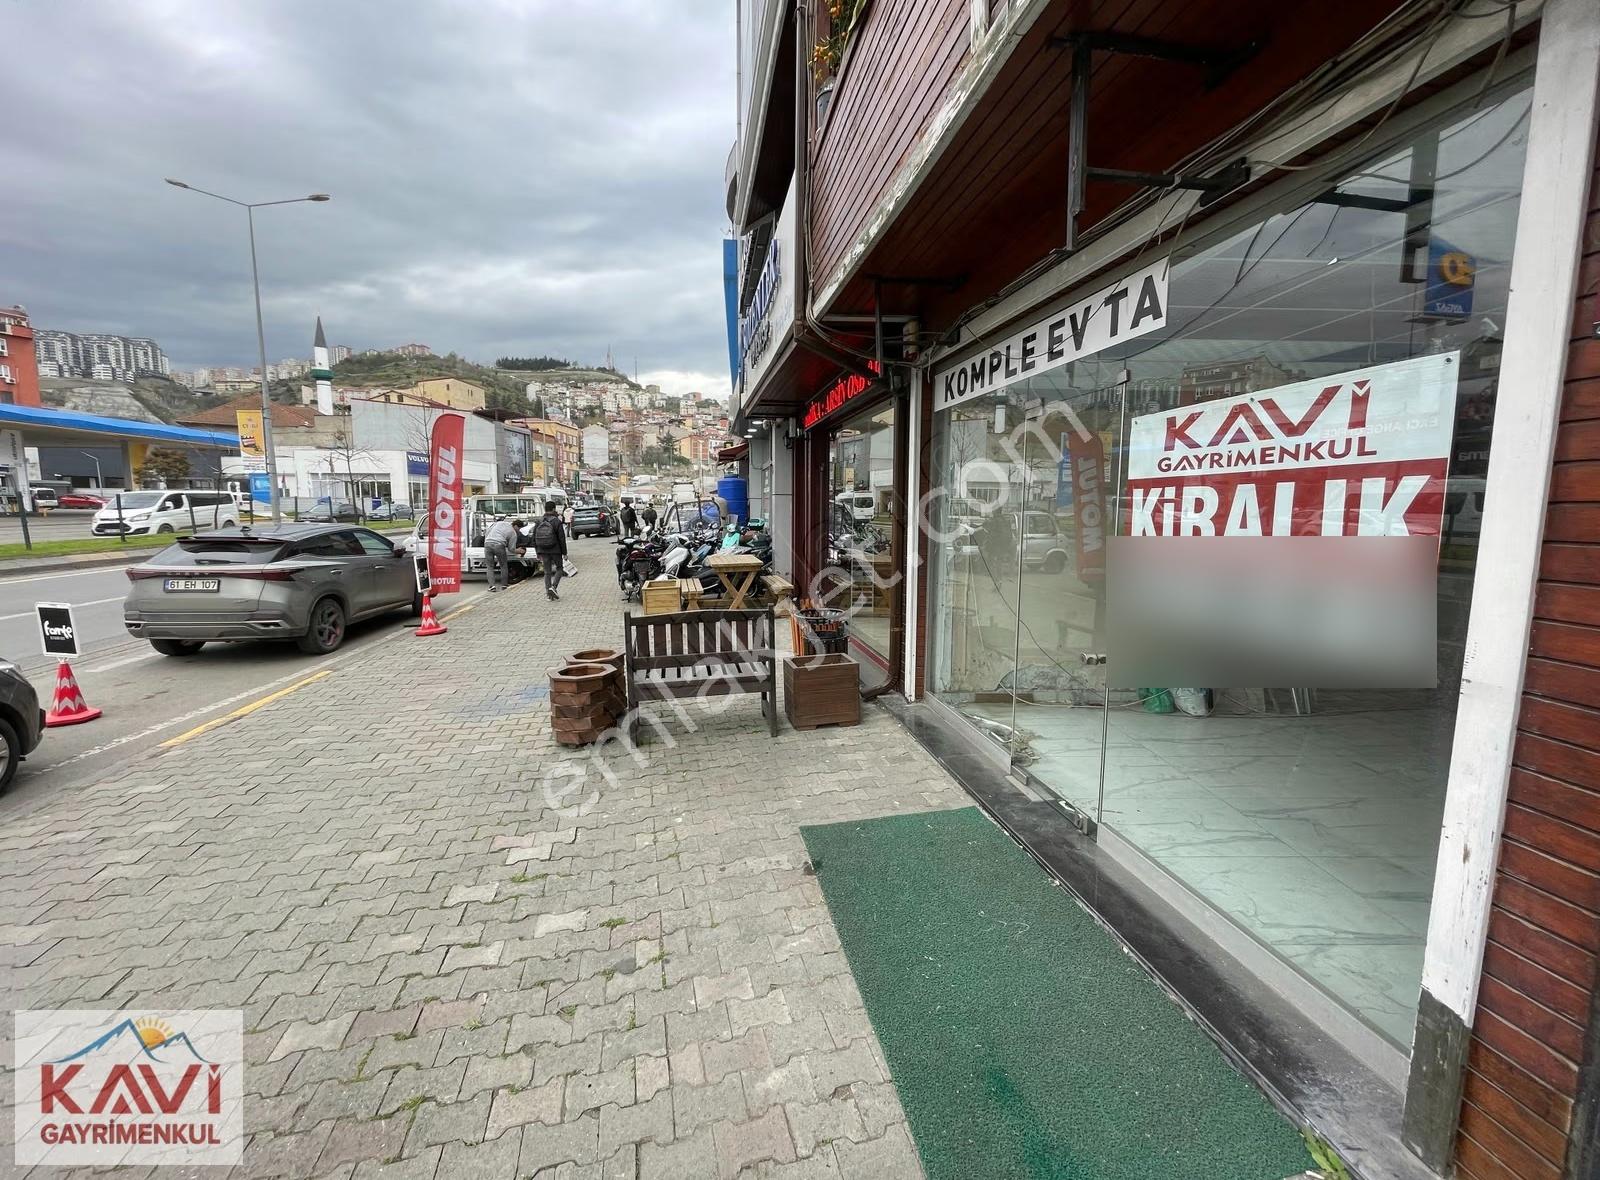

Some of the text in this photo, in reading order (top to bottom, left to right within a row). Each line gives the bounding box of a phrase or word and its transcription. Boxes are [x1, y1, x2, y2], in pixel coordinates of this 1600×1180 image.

[944, 331, 1036, 402] KOMPLE
[1047, 305, 1092, 361] EV
[1164, 380, 1371, 450] KAVİ
[408, 454, 429, 463] VOLVO
[1158, 438, 1377, 472] GAYRİMENKUL
[435, 446, 456, 560] MOTUL
